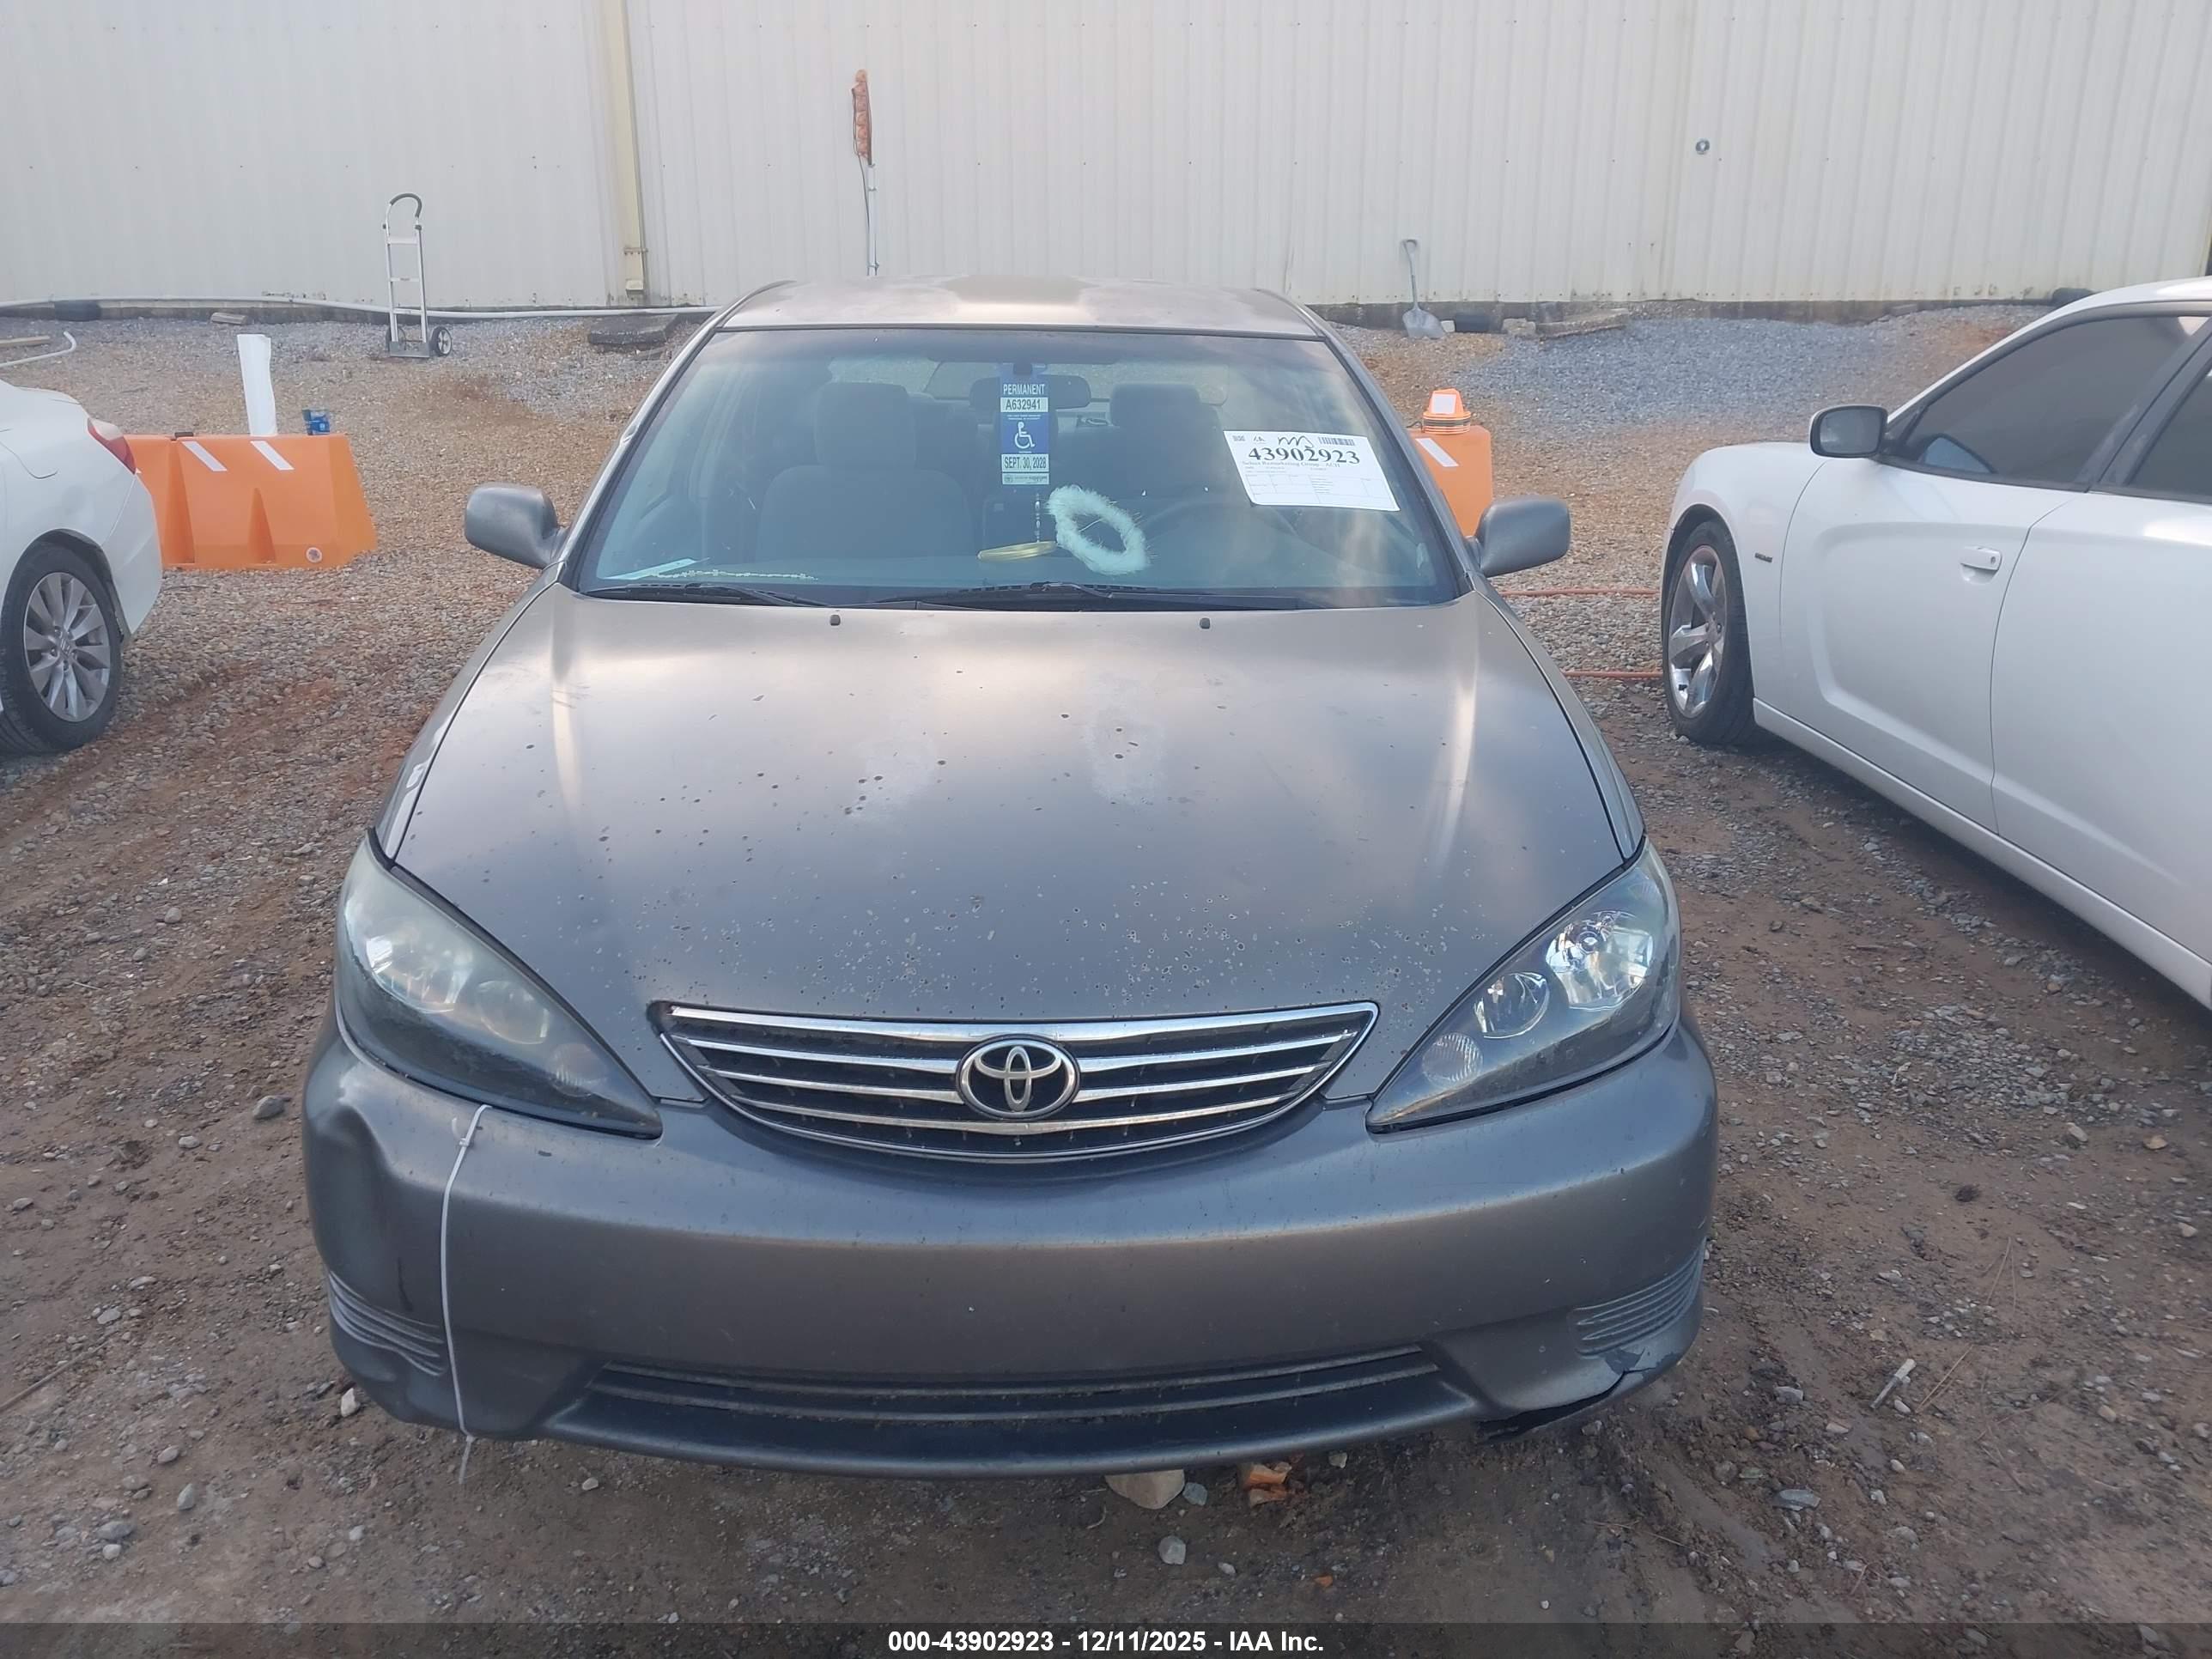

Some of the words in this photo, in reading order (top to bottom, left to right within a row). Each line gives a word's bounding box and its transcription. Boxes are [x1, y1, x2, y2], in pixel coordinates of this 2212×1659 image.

[1003, 383, 1045, 395] PERMANENT
[1006, 398, 1041, 410] A632941
[1248, 447, 1360, 465] 43902923
[1005, 456, 1021, 469] SEPT.
